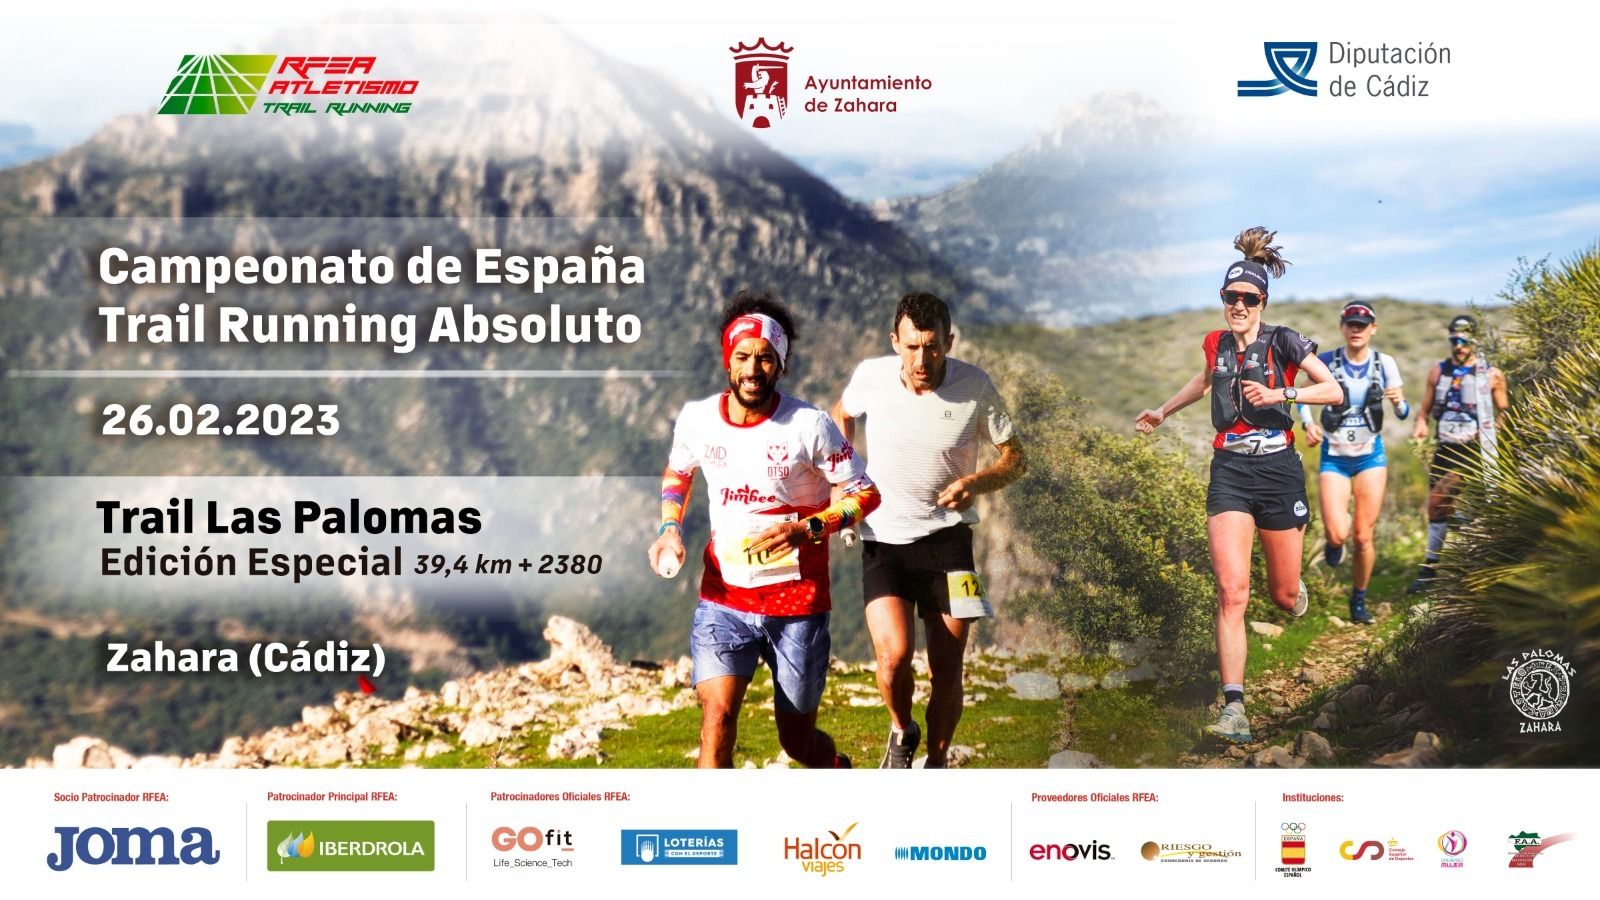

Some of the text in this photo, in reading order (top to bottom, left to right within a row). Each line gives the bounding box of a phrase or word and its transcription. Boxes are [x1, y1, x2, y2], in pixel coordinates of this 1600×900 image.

[1346, 429, 1356, 442] 8
[704, 444, 727, 460] ZAID
[1249, 439, 1261, 454] 7
[720, 483, 777, 507] Jimbee
